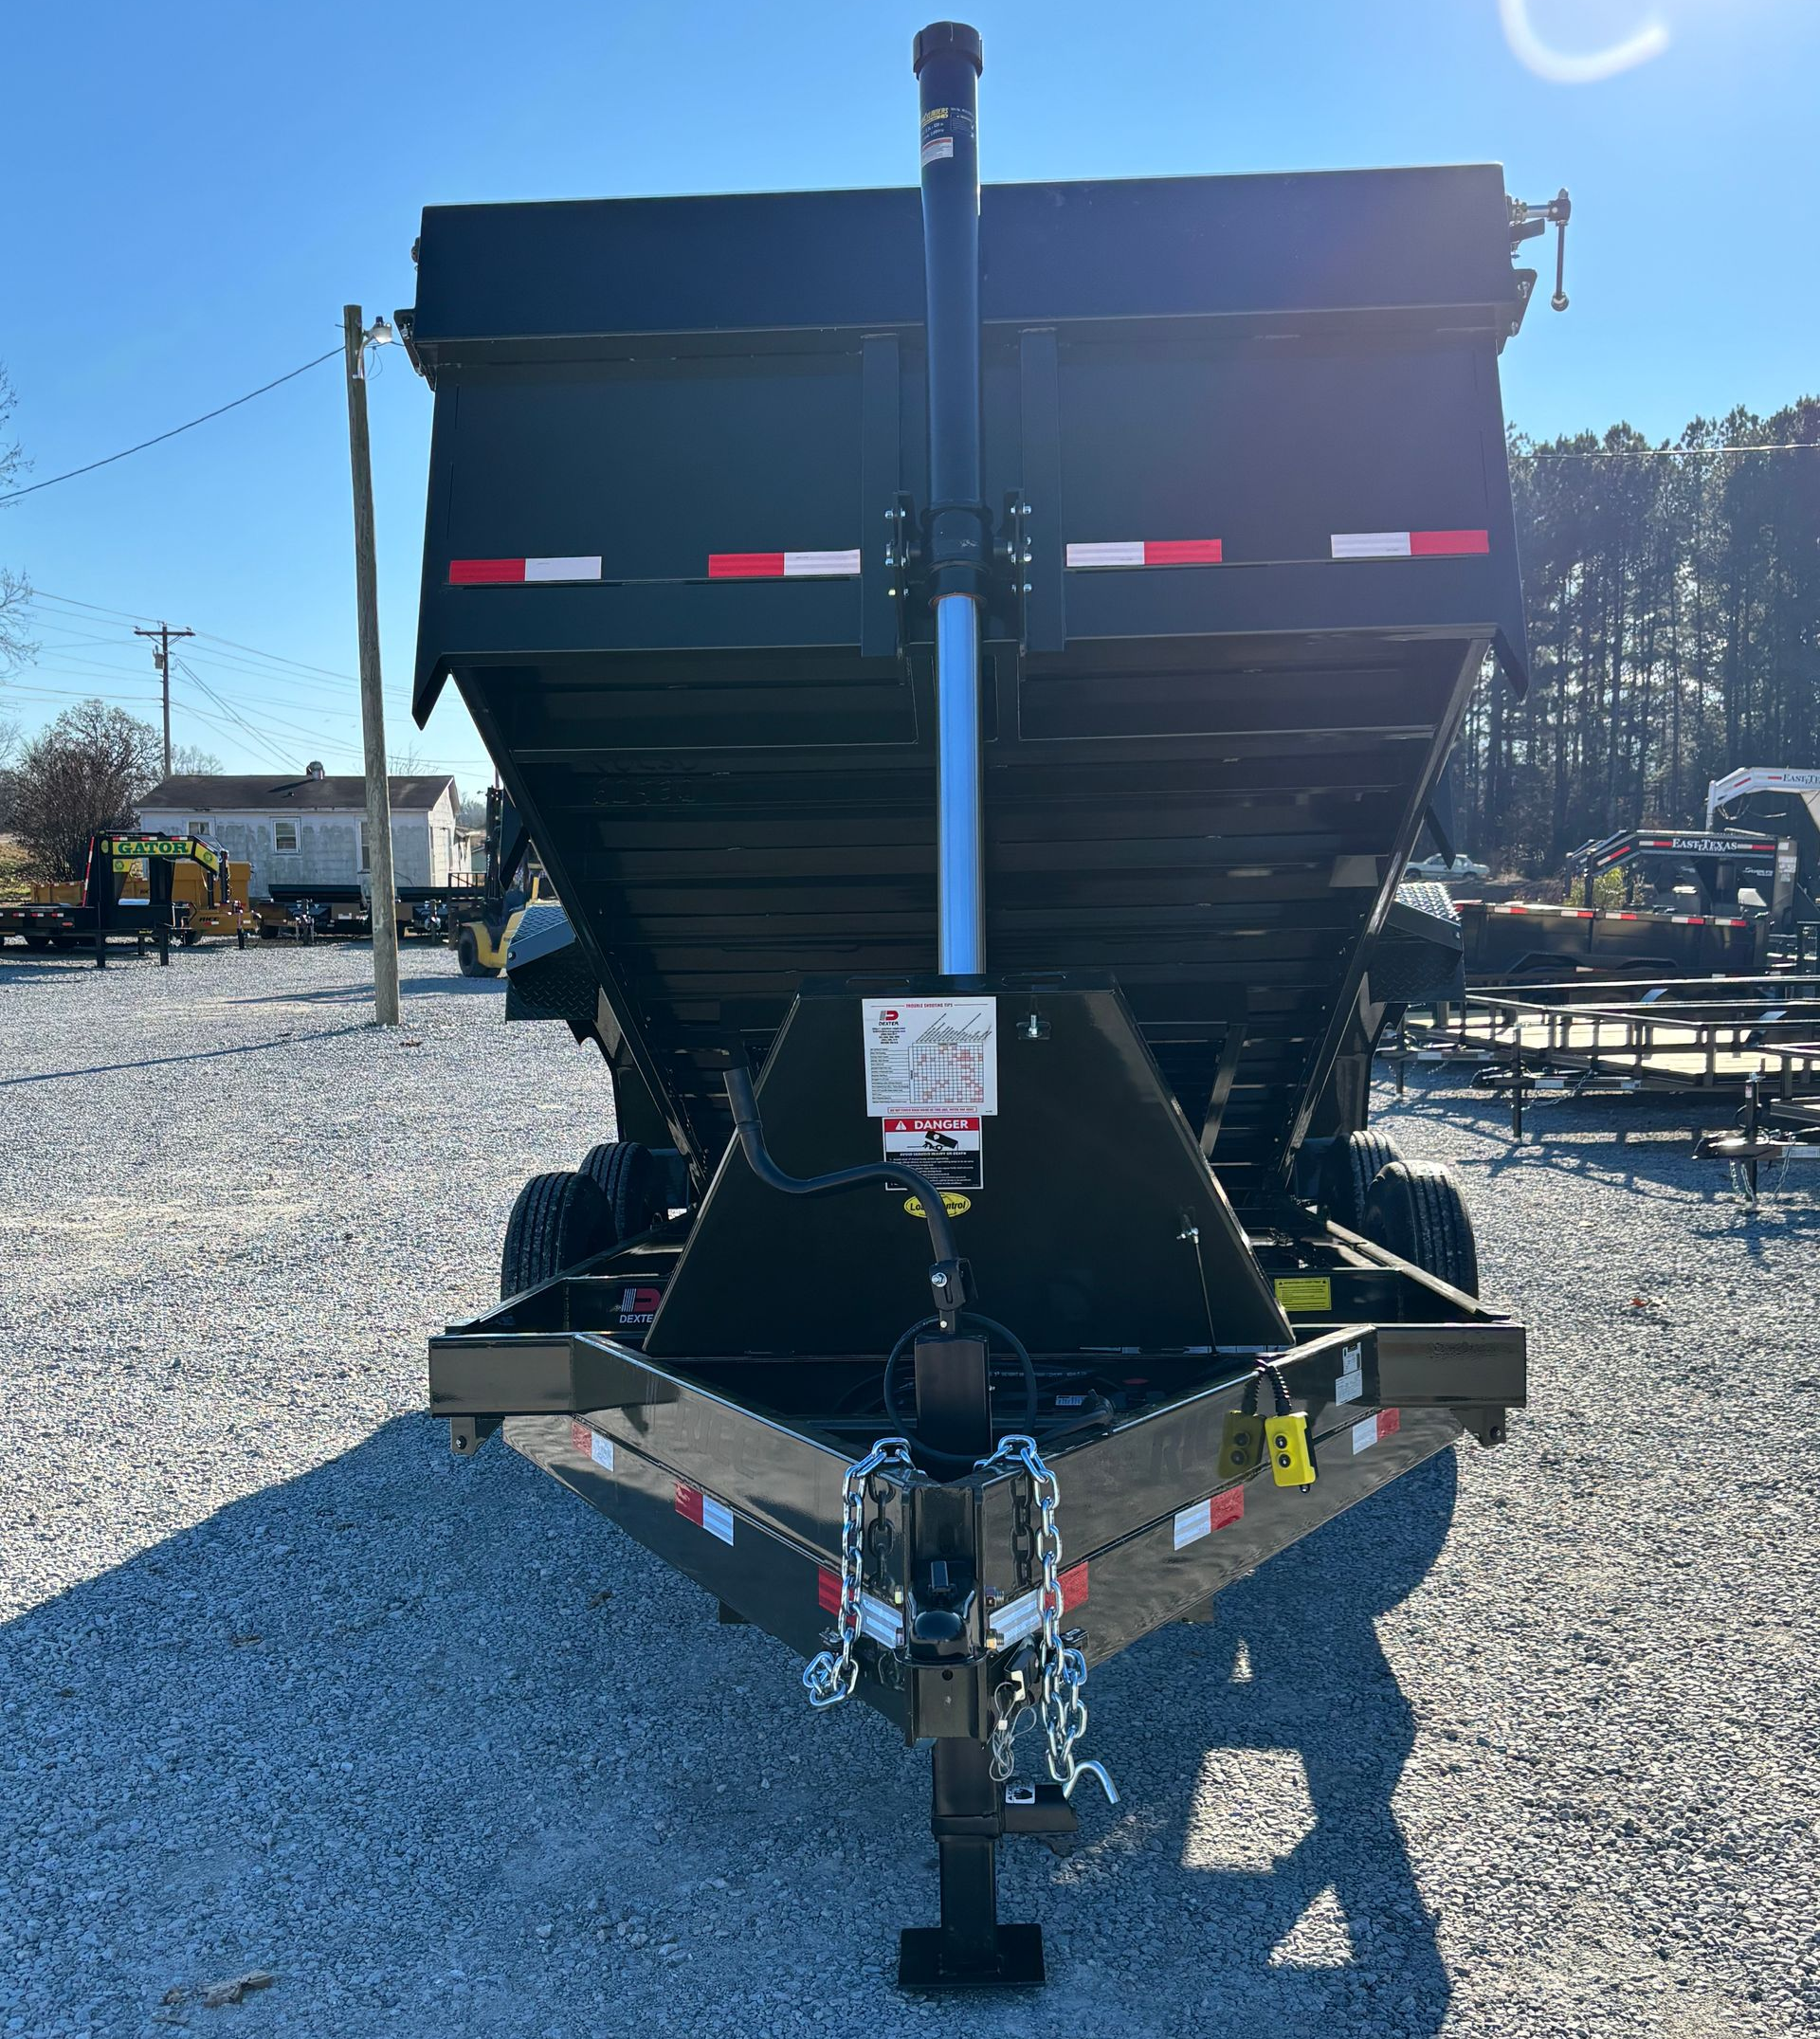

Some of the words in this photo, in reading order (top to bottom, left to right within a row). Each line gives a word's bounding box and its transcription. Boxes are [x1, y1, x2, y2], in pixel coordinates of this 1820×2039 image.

[118, 842, 189, 854] GATOR
[1672, 838, 1700, 848] EAST
[1701, 839, 1738, 850] TEXAS
[914, 1120, 969, 1130] DANGER
[619, 1314, 654, 1323] DEXTE
